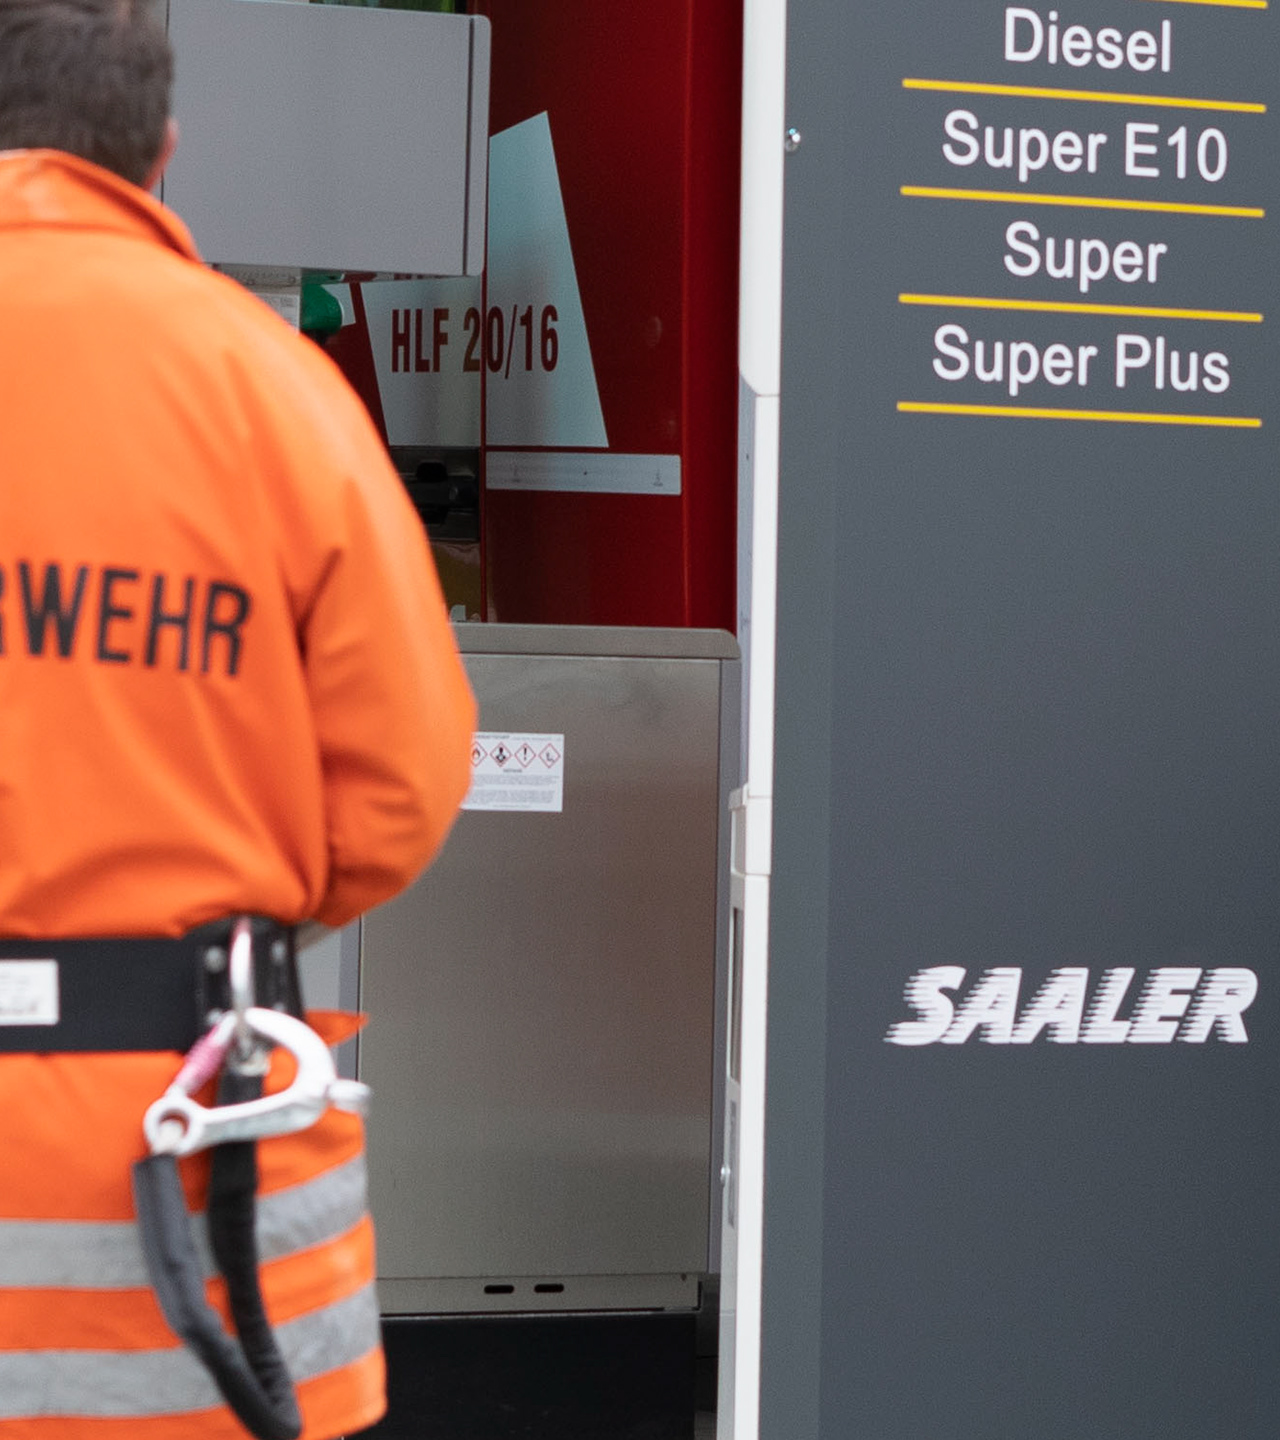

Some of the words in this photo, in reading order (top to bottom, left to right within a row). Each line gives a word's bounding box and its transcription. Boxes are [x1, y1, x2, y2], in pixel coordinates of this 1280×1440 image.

[1003, 7, 1172, 73] Diesel
[941, 109, 1107, 182] Super
[1124, 122, 1228, 182] E10
[1003, 221, 1167, 292] Super
[391, 308, 449, 373] HLF
[463, 304, 559, 380] 20/16
[932, 324, 1097, 396] Super
[1115, 334, 1231, 393] Plus
[883, 965, 1259, 1046] SAALER
